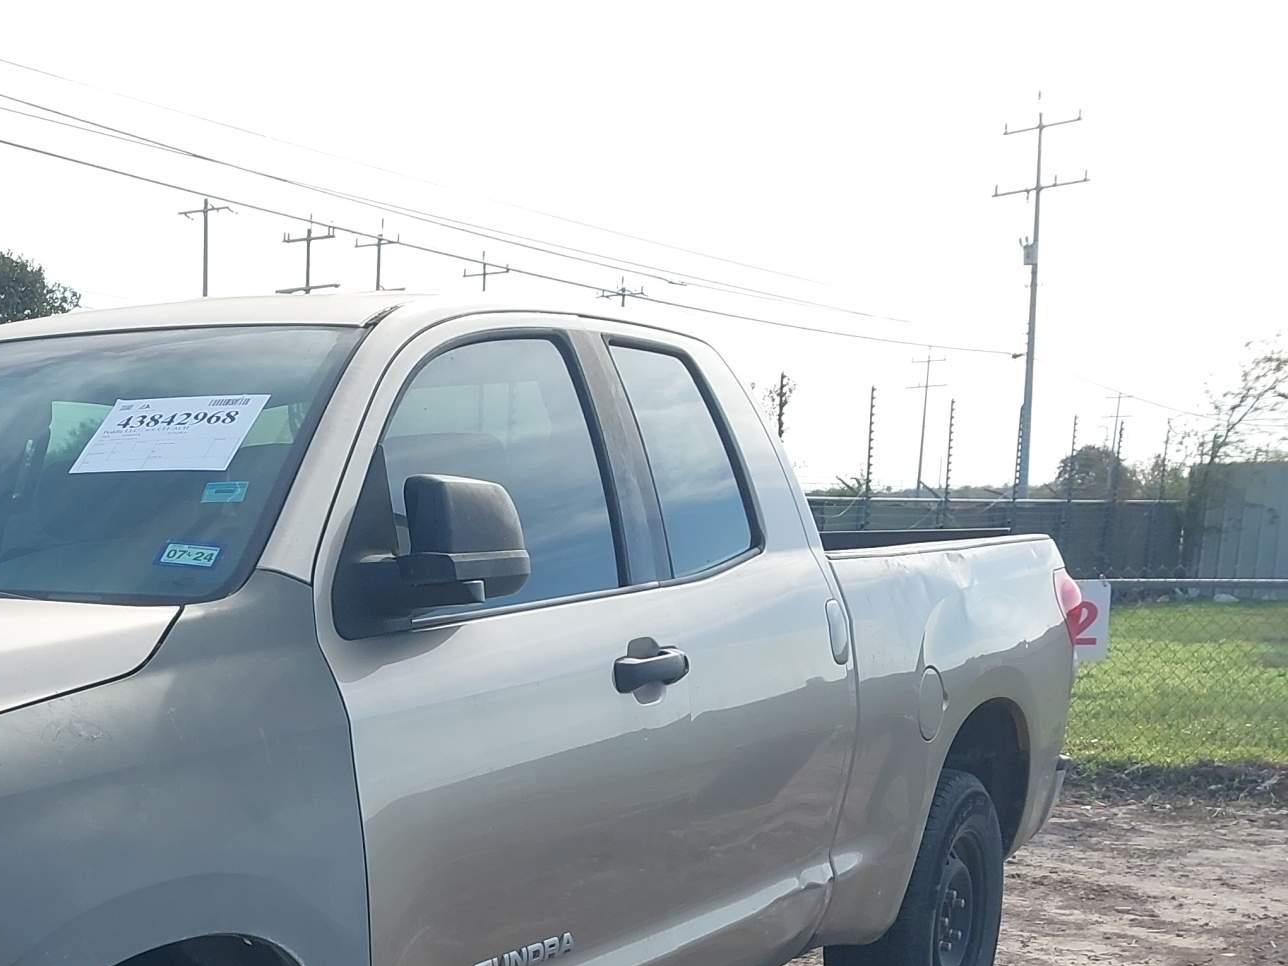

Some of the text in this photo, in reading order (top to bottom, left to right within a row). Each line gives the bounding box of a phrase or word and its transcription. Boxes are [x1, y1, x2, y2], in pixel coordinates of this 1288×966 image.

[117, 410, 239, 430] 43842968
[166, 549, 214, 563] 07 24
